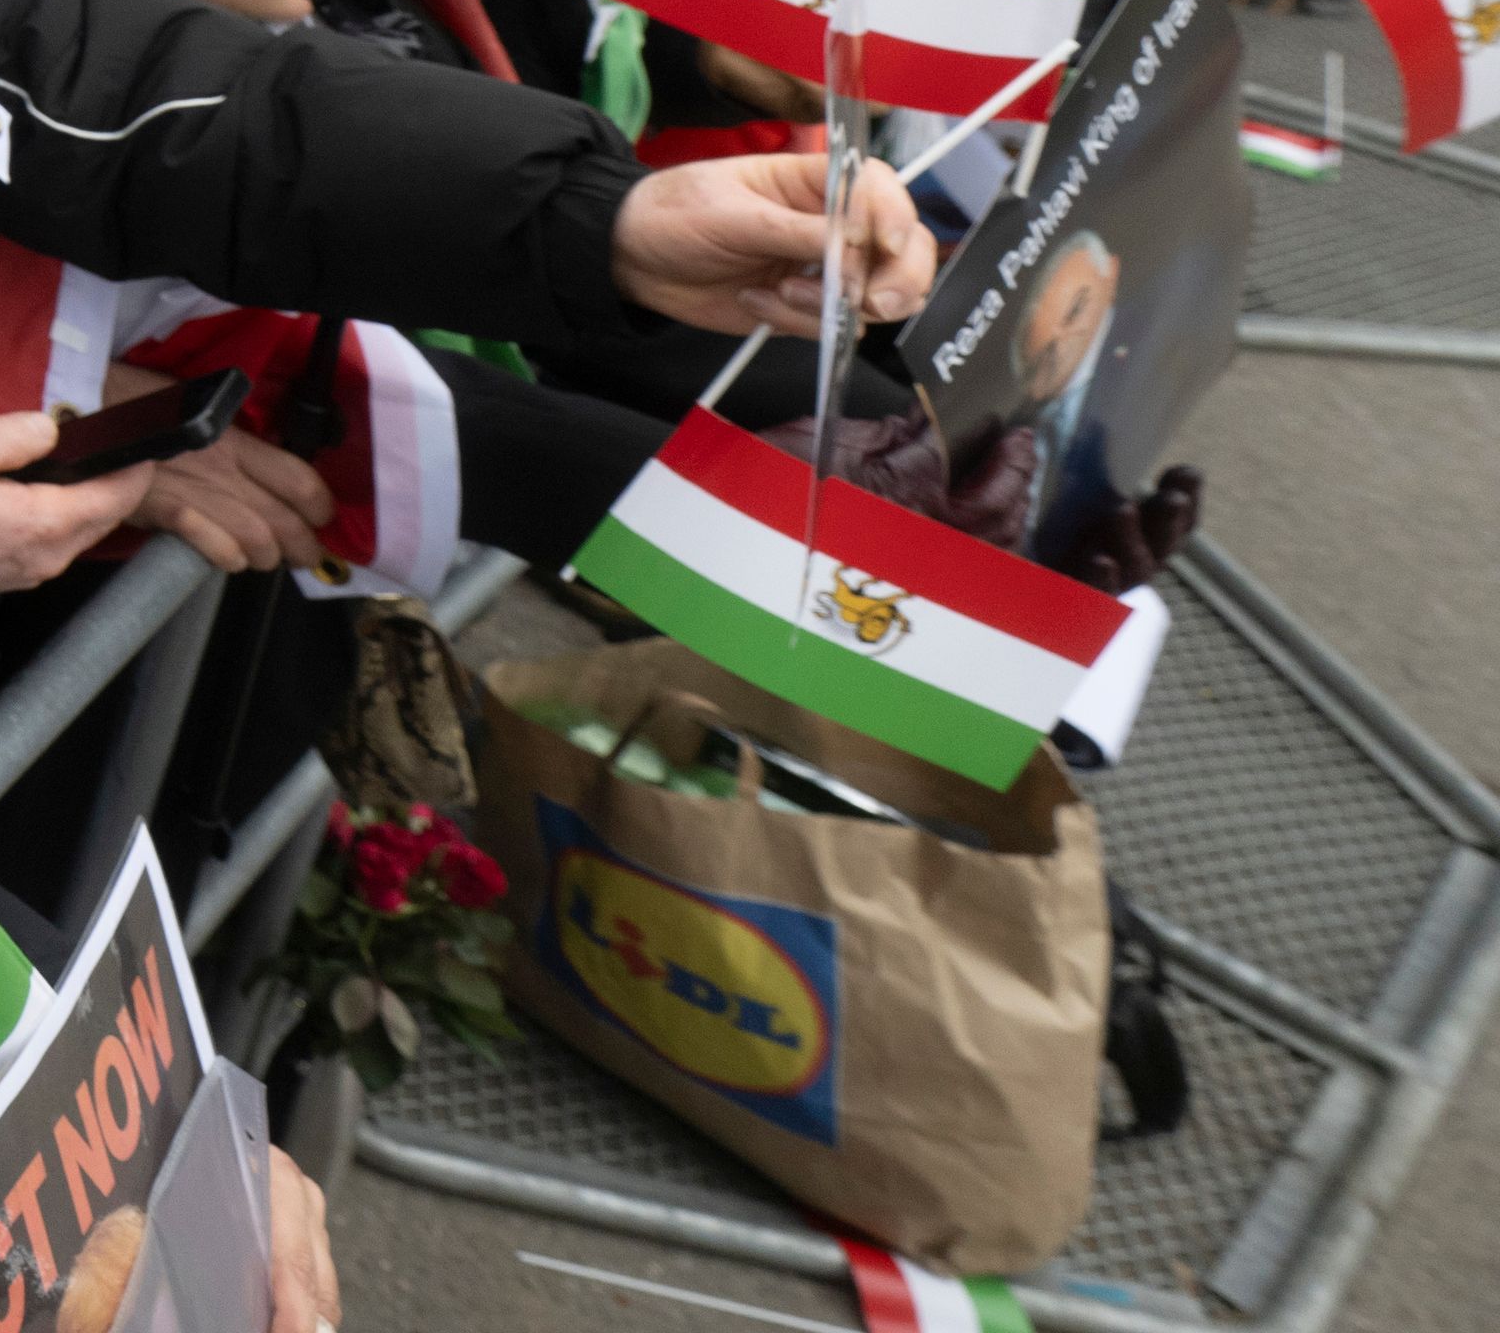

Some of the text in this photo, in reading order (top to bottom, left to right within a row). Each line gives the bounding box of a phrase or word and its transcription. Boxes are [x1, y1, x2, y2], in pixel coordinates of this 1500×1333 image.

[932, 288, 1005, 383] Reza
[998, 156, 1088, 290] Pahlavi
[1080, 84, 1140, 165] King
[1132, 36, 1162, 85] of
[53, 945, 175, 1235] NOW
